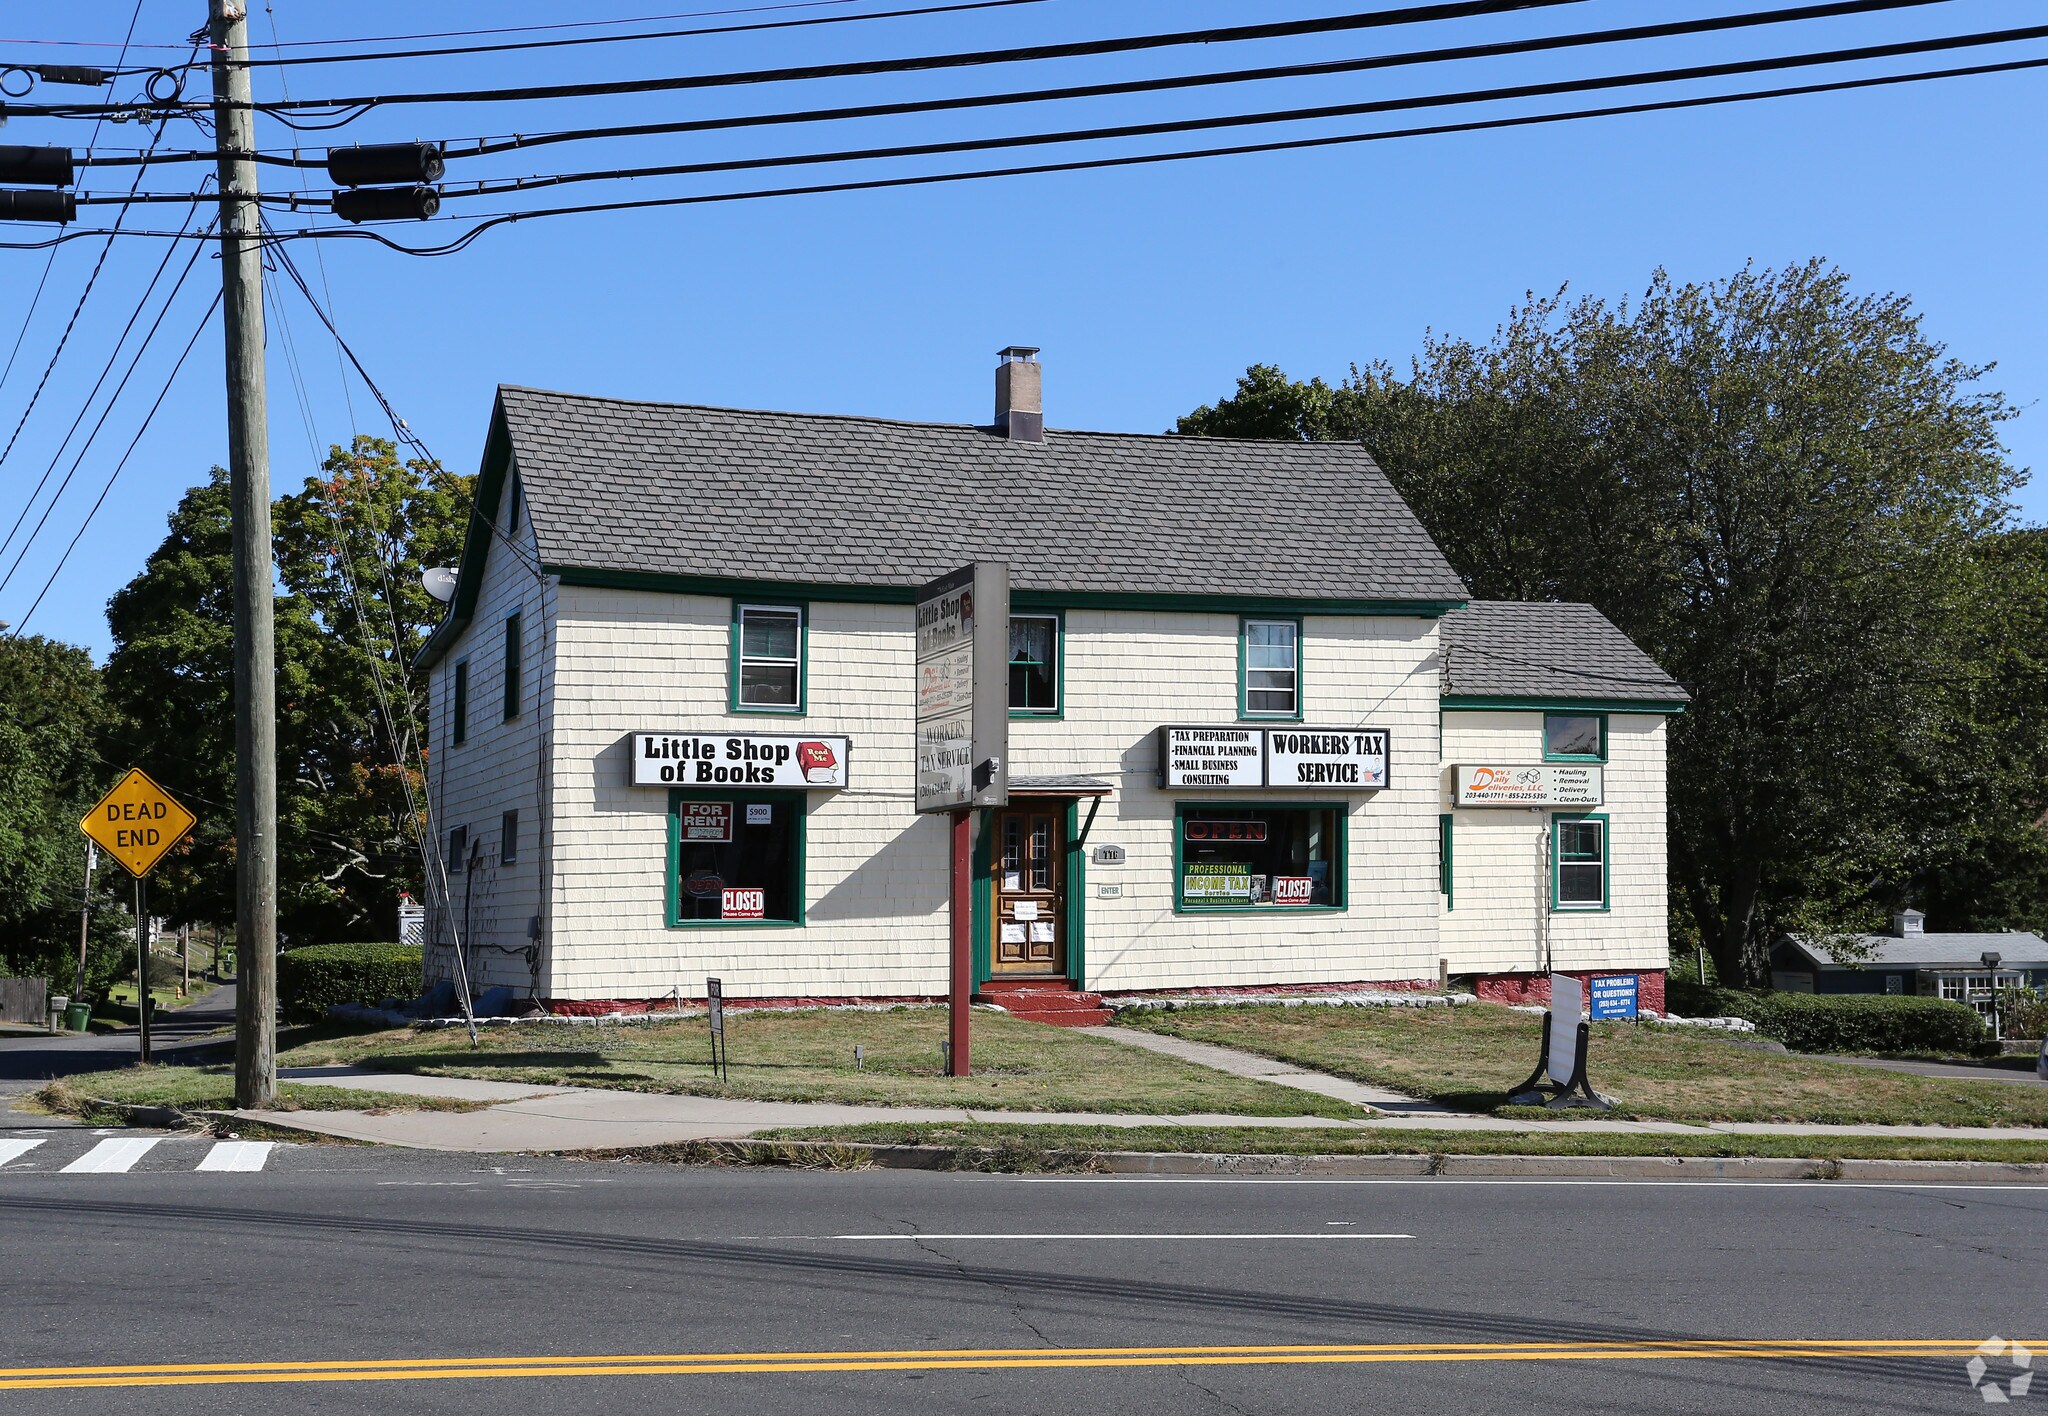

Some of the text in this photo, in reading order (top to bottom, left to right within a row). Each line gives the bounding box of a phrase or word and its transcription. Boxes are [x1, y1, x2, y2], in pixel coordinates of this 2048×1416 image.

[918, 604, 938, 628] Little
[941, 598, 959, 619] Shop
[932, 622, 956, 646] Books
[926, 719, 965, 744] WORKERS
[1193, 732, 1249, 742] PREPARATION
[645, 737, 789, 765] Little Shop
[1218, 746, 1257, 756] PLANNING
[1273, 734, 1383, 755] WORKERS TAX
[921, 754, 935, 773] TAX
[937, 746, 970, 769] SERVICE
[1202, 760, 1238, 770] BUSINESS
[660, 761, 774, 783] of Books
[1182, 774, 1229, 784] CONSULTING
[1298, 762, 1358, 783] SERVICE
[107, 802, 166, 821] DEAD
[690, 804, 722, 815] FOR
[684, 816, 728, 826] RENT
[117, 828, 160, 847] END
[1190, 822, 1264, 838] OPEN
[1189, 865, 1247, 874] PROFESSIONAL
[1186, 877, 1226, 890] INCOME
[1228, 877, 1249, 890] TAX
[1278, 880, 1310, 897] CLOSED
[723, 891, 763, 910] CLOSED
[1607, 978, 1634, 987] PROBLEMS
[1602, 989, 1635, 998] QUESTIONS?
